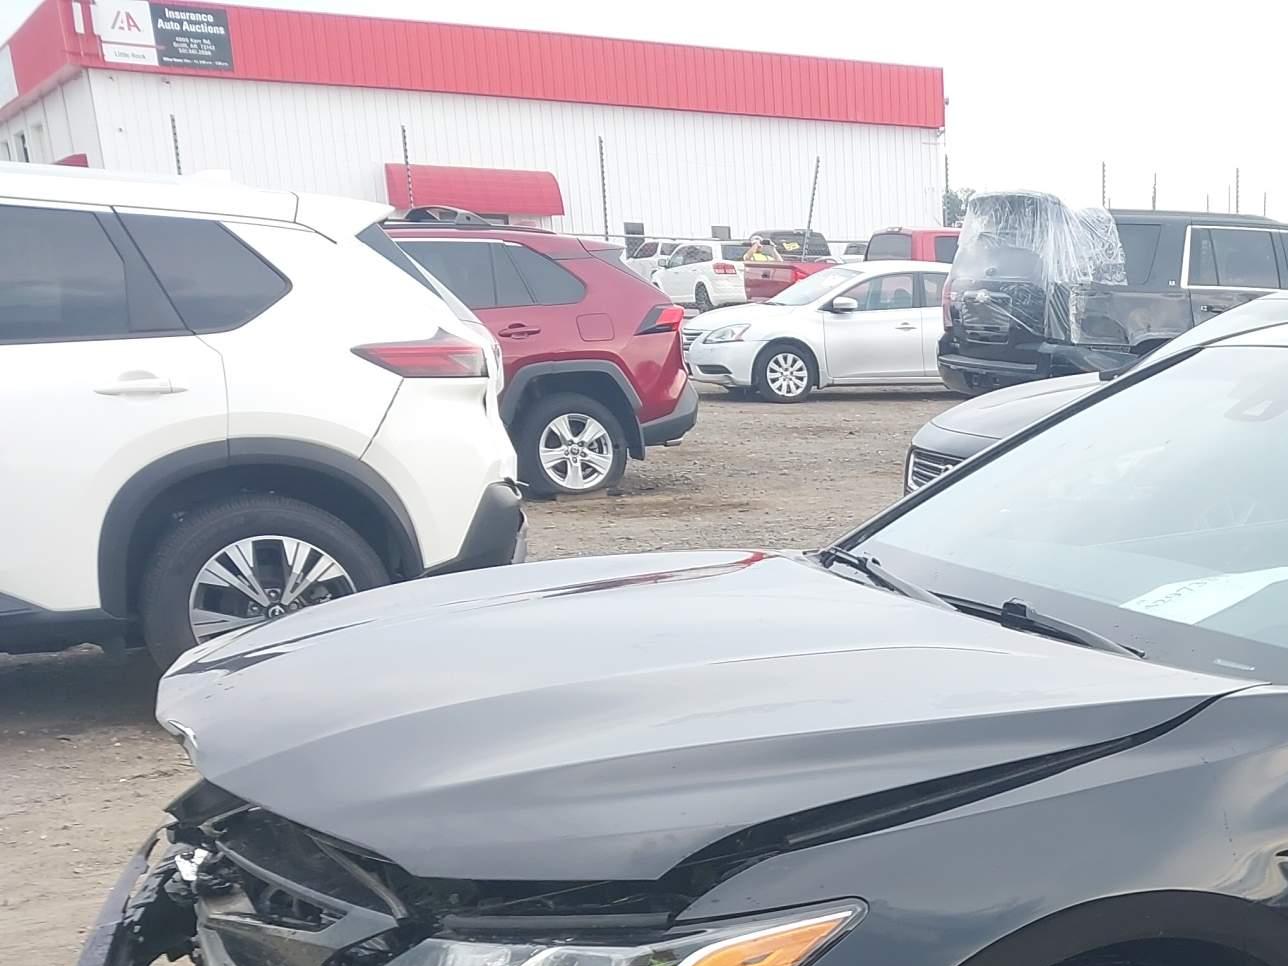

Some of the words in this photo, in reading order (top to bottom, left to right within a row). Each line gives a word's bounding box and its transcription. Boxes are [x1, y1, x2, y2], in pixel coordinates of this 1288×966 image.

[165, 8, 214, 22] Insurance
[157, 19, 181, 30] Auto
[182, 22, 225, 35] Auctions
